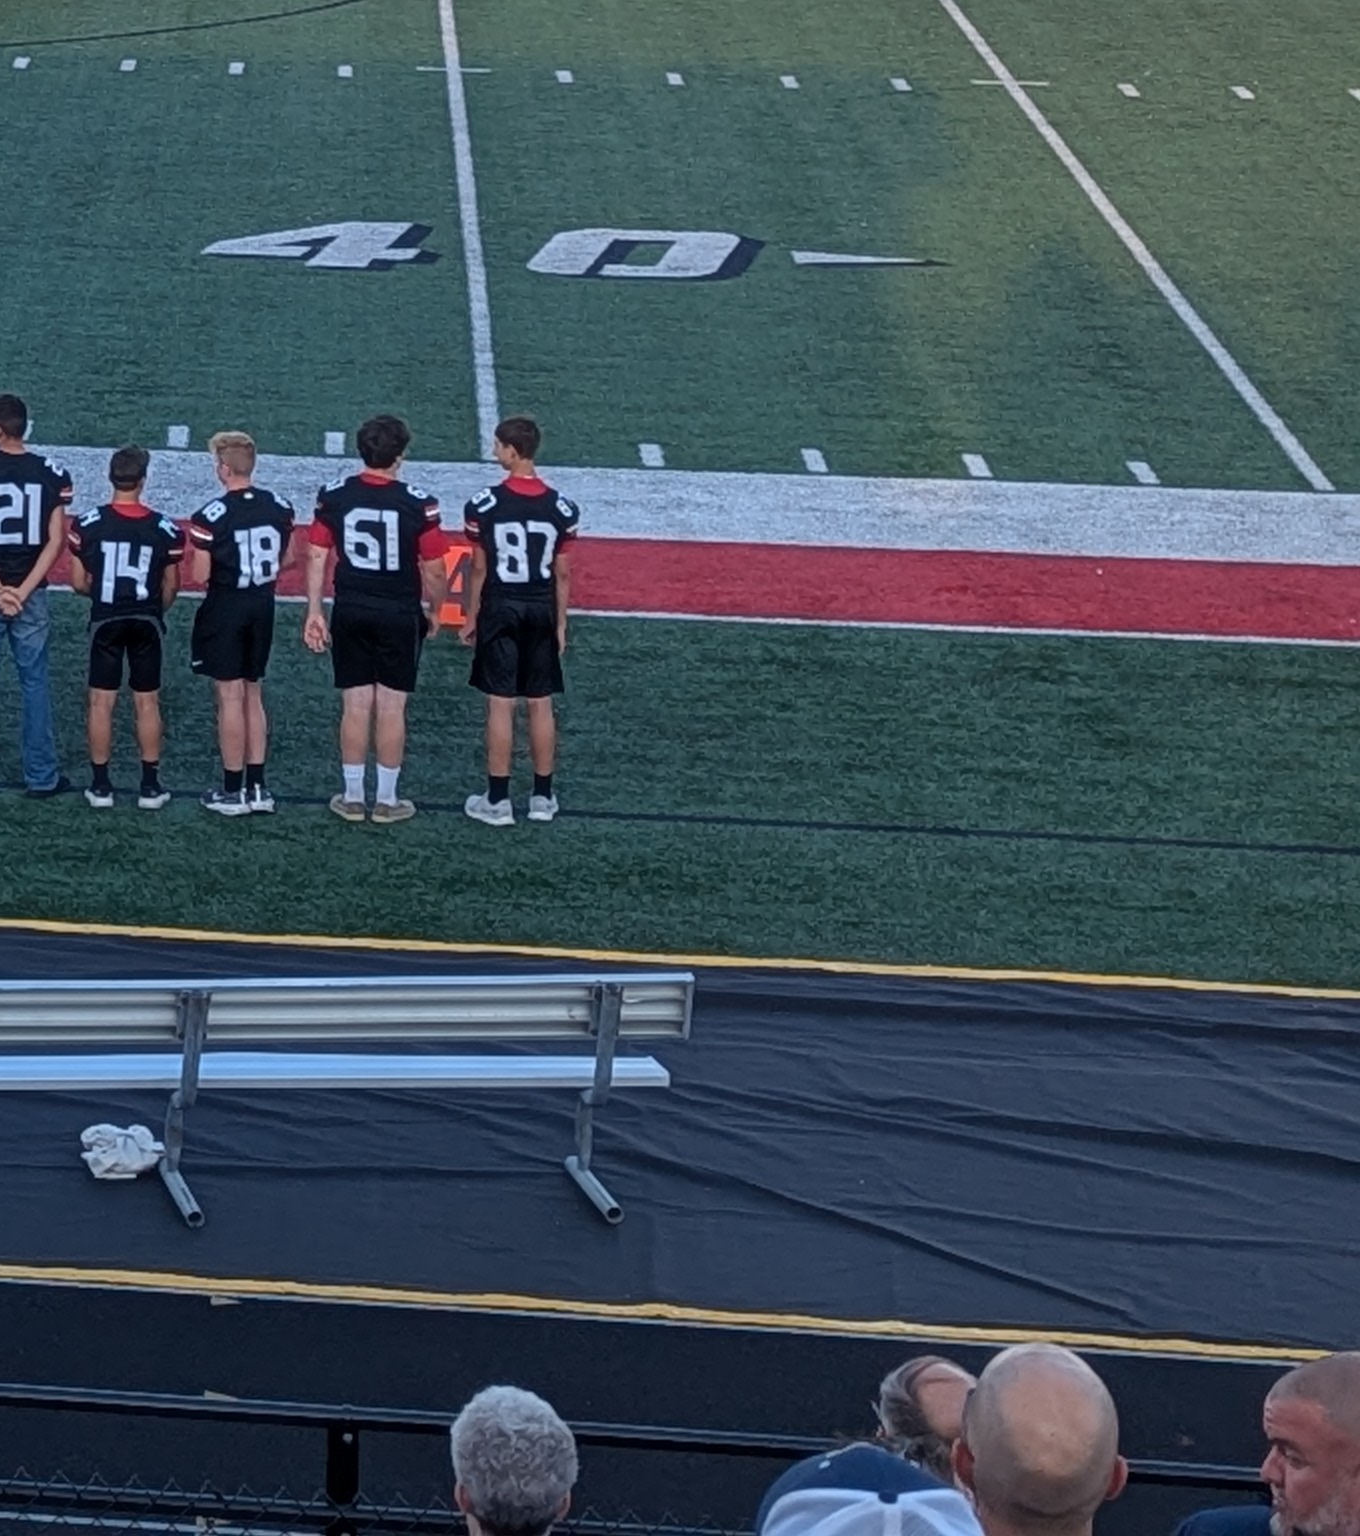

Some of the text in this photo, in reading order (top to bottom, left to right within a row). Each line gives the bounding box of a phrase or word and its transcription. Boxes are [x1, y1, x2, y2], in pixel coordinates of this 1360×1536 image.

[200, 221, 760, 279] 40
[202, 498, 228, 523] 18
[471, 487, 497, 514] 87
[234, 524, 282, 588] 18
[344, 507, 400, 571] 61
[493, 520, 559, 584] 87
[100, 540, 153, 604] 14
